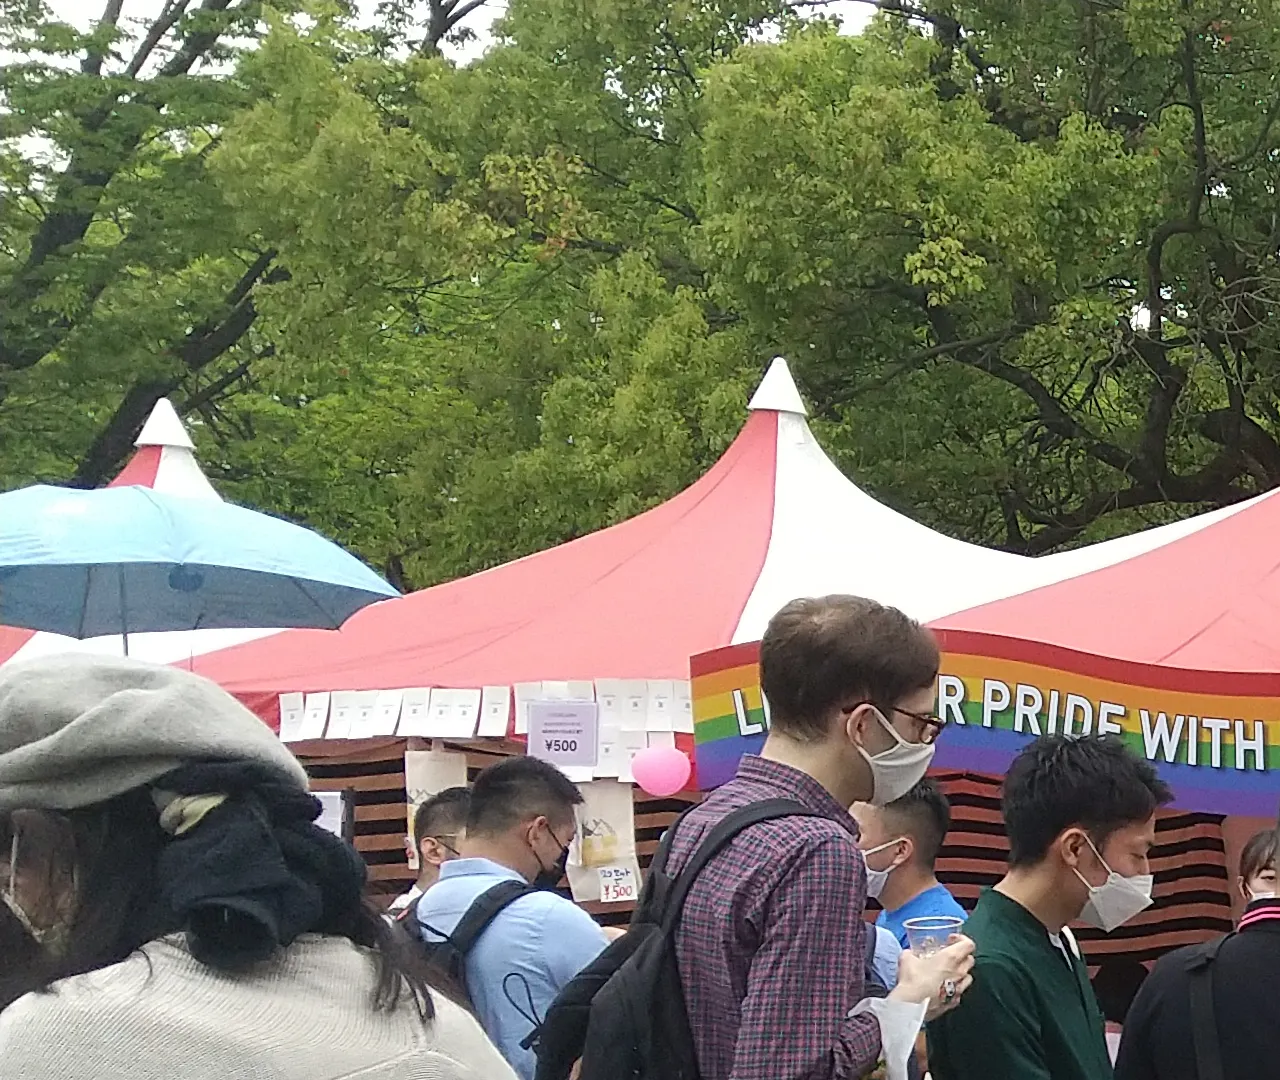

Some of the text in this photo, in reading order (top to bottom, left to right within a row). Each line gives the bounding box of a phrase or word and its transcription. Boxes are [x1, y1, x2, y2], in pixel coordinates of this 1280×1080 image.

[982, 678, 1127, 737] PRIDE
[1138, 709, 1266, 771] WITH
[545, 740, 577, 752] ¥500
[604, 885, 633, 900] ¥500
